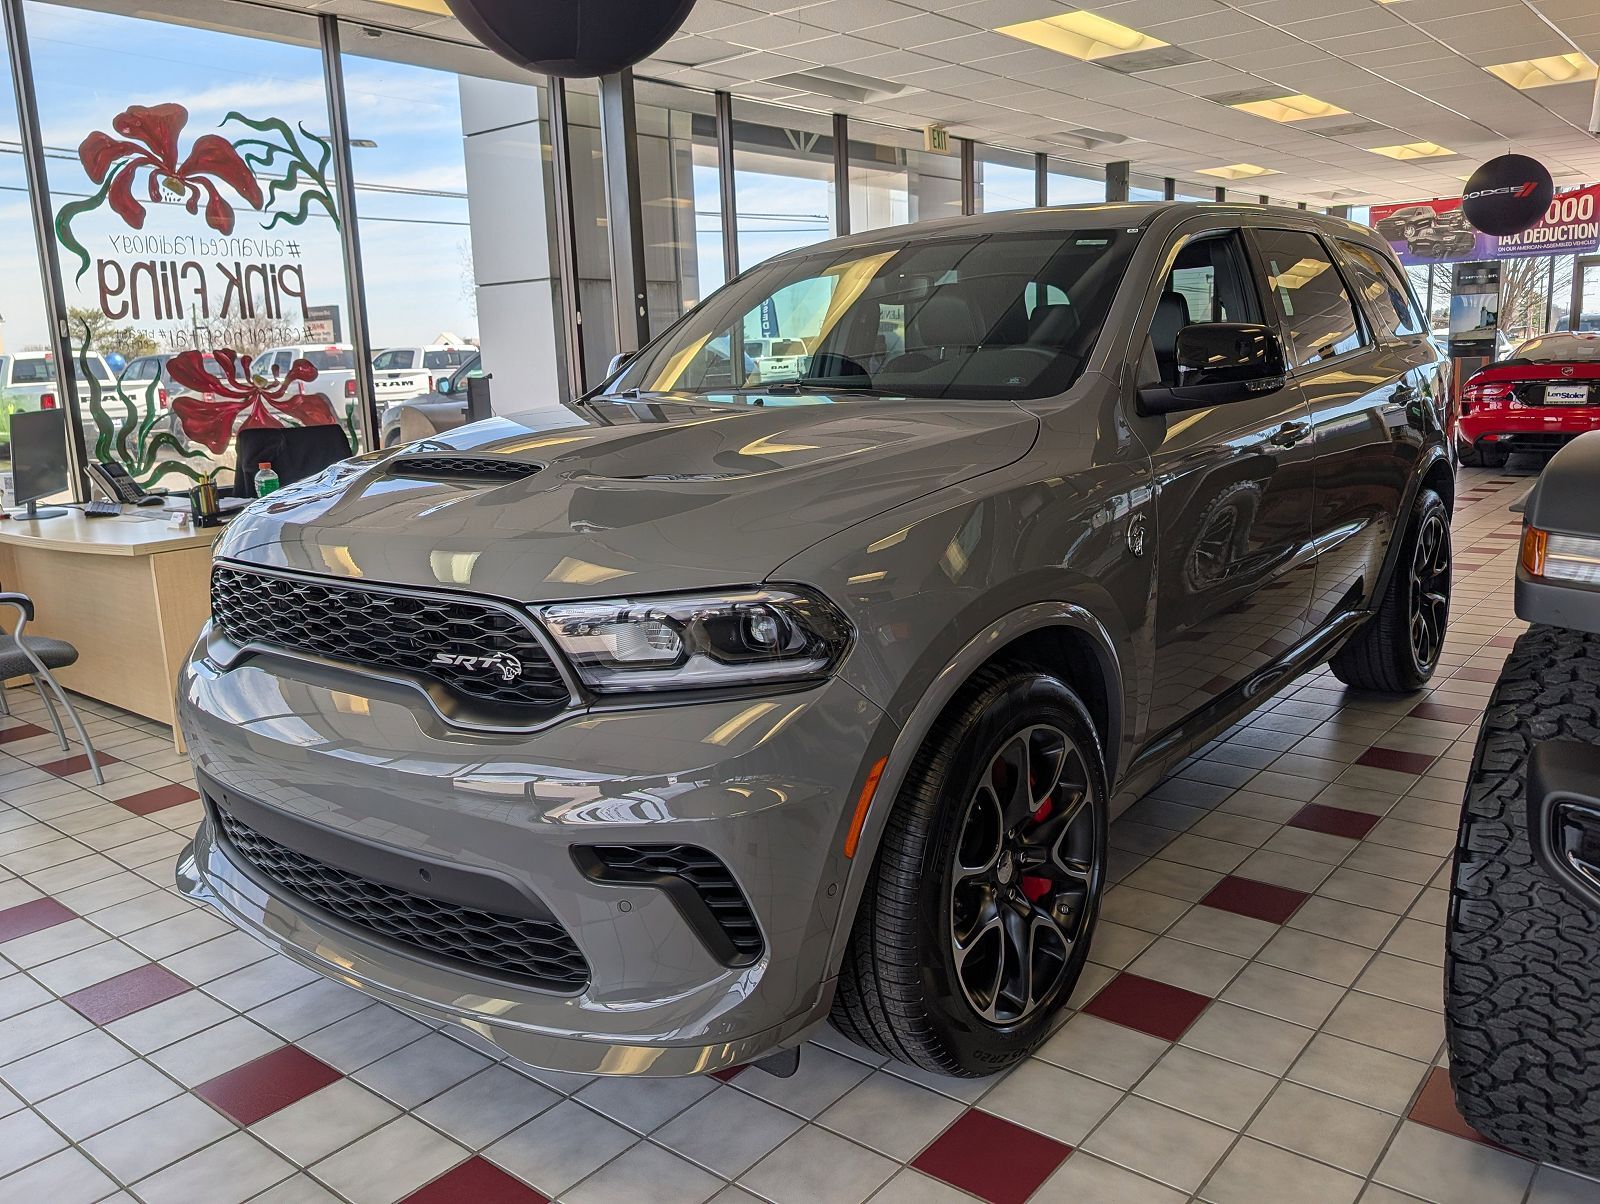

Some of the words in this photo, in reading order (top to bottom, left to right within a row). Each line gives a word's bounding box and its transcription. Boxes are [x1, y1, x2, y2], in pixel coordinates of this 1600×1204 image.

[932, 129, 947, 150] EXIT
[1463, 185, 1525, 201] DODGE
[1524, 222, 1599, 244] DEDUCTION
[432, 653, 502, 671] SRT
